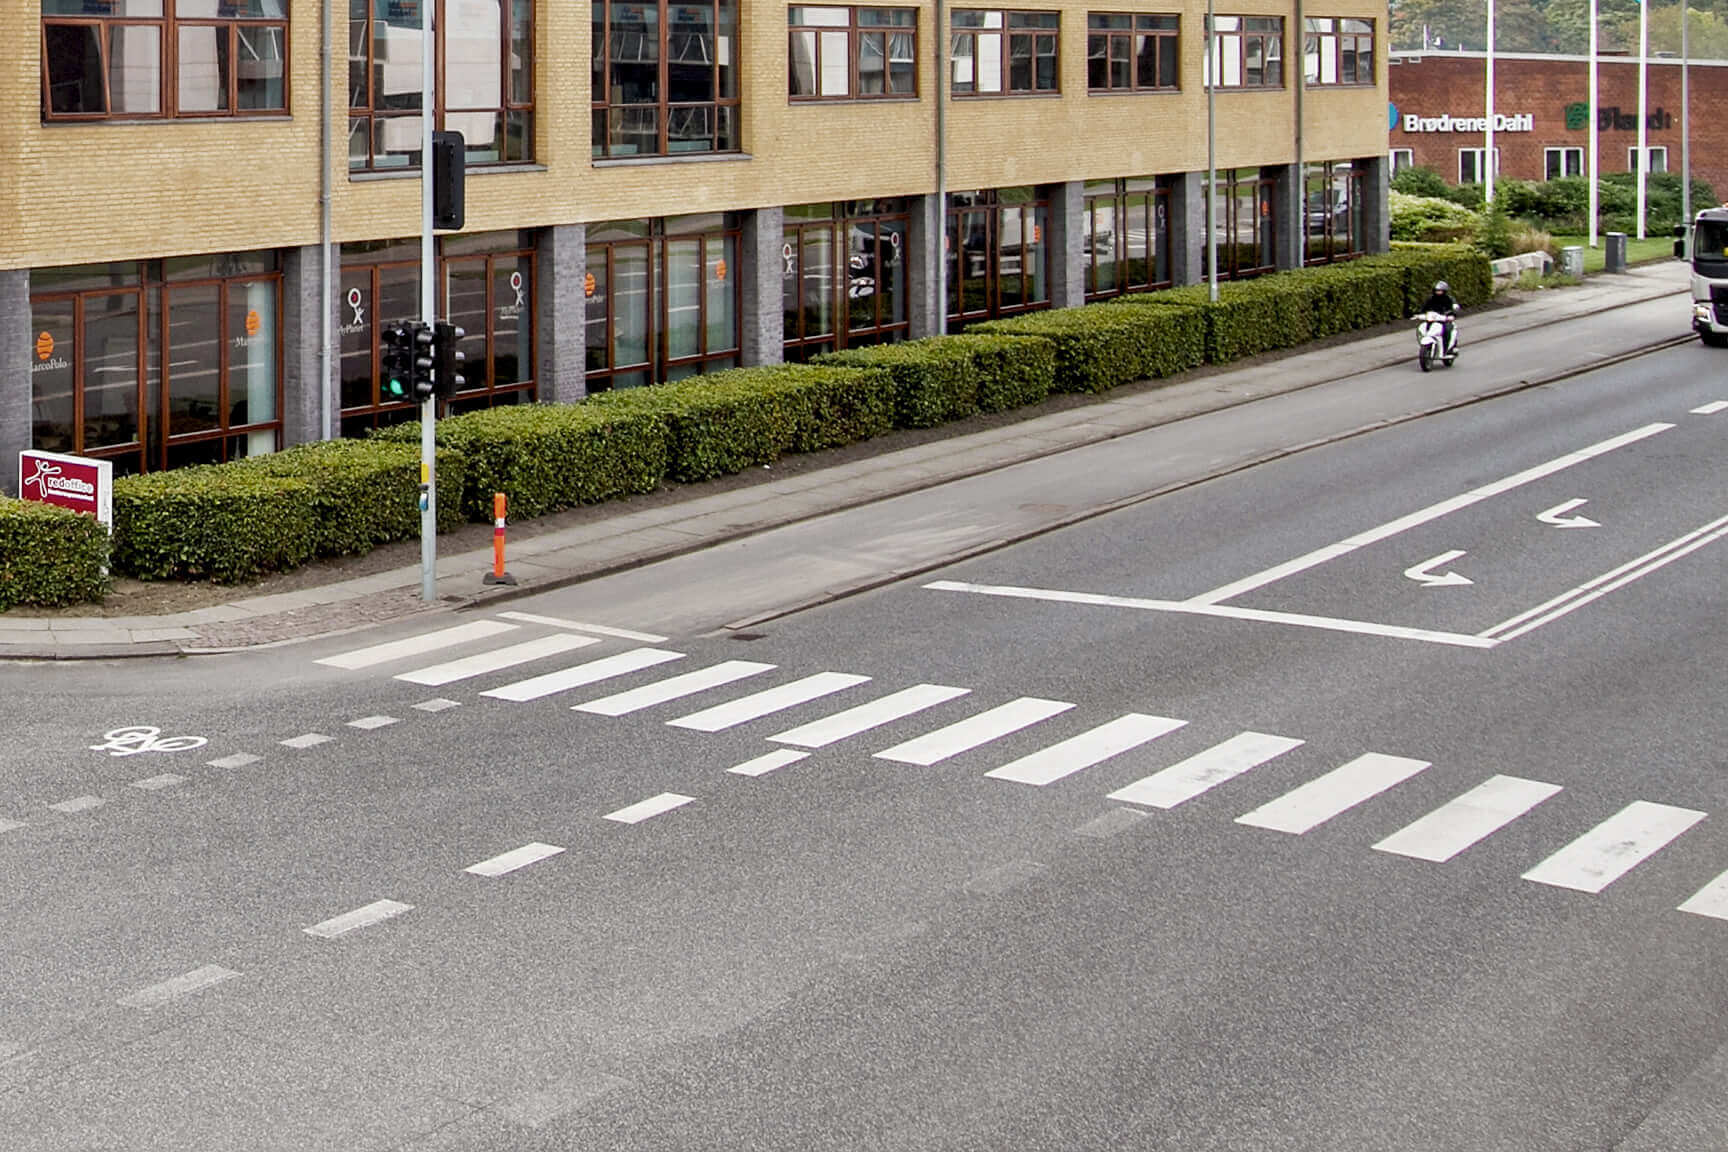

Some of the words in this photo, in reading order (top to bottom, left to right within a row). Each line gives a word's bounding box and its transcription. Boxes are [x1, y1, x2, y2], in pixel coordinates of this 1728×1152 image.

[1403, 114, 1486, 133] Brødrene
[1493, 112, 1535, 133] Dahl
[48, 477, 94, 494] redoffice
